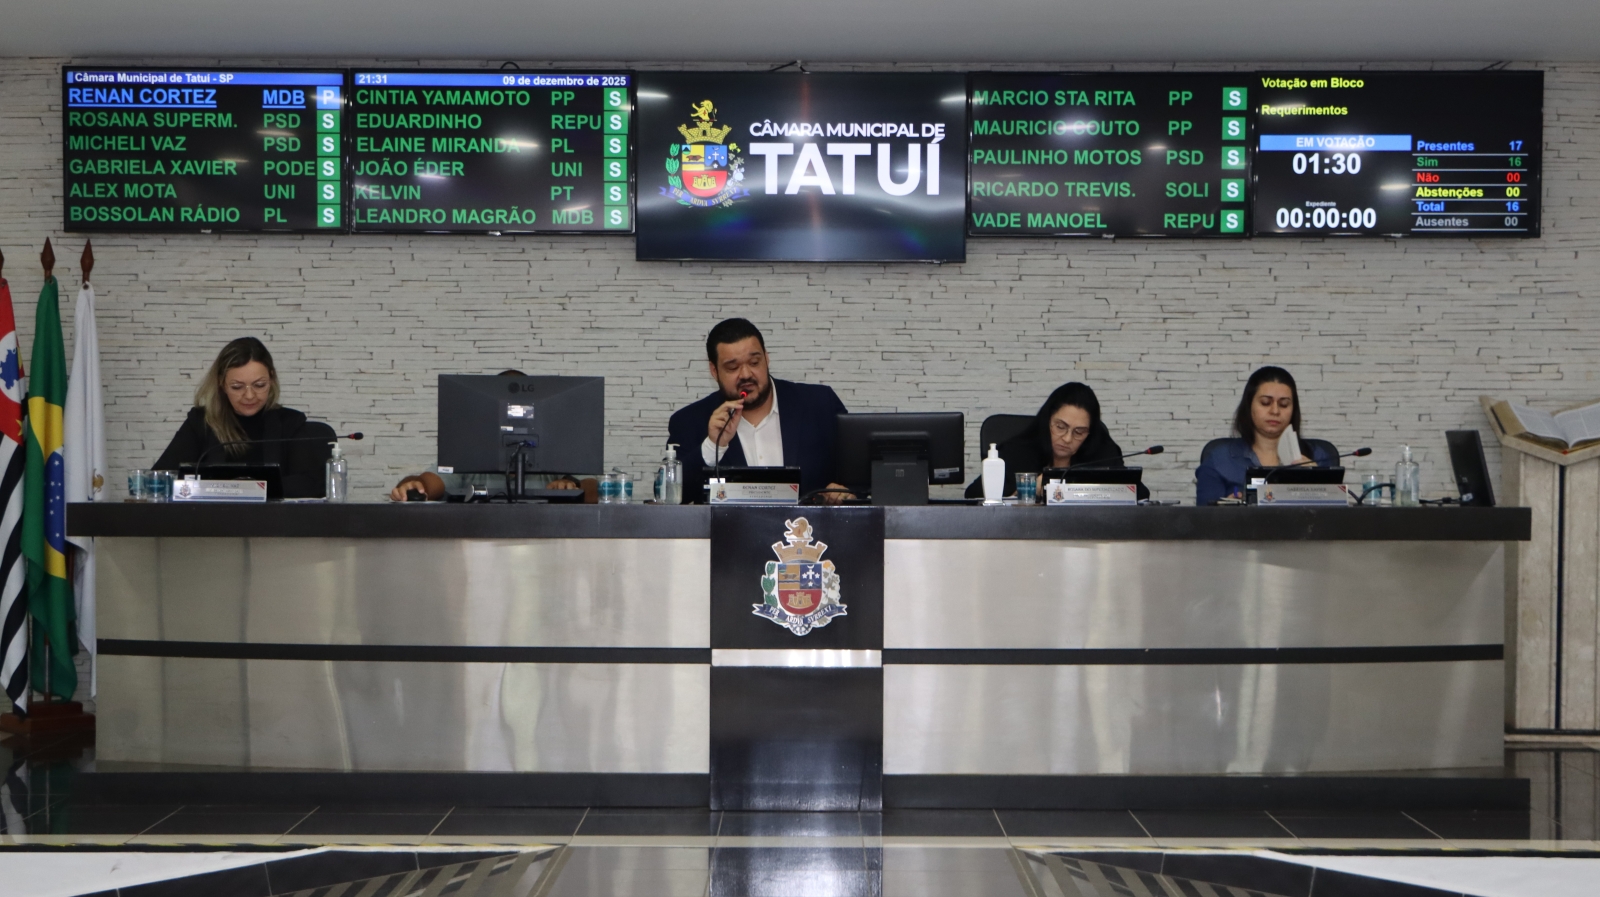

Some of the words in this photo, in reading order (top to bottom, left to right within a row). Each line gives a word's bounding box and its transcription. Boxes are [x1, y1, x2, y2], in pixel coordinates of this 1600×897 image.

[75, 73, 115, 83] Câmara
[117, 73, 167, 84] Municipal
[170, 74, 183, 83] de
[185, 73, 210, 83] Tatuí
[219, 74, 234, 83] SP
[359, 75, 387, 84] 21:31
[503, 76, 515, 85] 09
[518, 76, 531, 85] de
[533, 76, 584, 85] dezembro
[586, 77, 599, 85] de
[602, 77, 626, 86] 2025
[1262, 78, 1307, 90] Votação
[1310, 80, 1327, 88] em
[1331, 78, 1364, 88] Bloco
[69, 89, 133, 104] RENAN
[140, 89, 216, 104] CORTEZ
[263, 90, 305, 104] MDB
[323, 90, 334, 105] P
[356, 90, 418, 105] CINTIA
[422, 90, 530, 105] YAMAMOTO
[551, 92, 575, 106] PP
[609, 91, 621, 106] S
[973, 90, 1048, 105] MARCIO
[1054, 91, 1089, 105] STA
[1095, 91, 1135, 106] RITA
[1169, 91, 1193, 106] PP
[1229, 91, 1241, 106] S
[1261, 105, 1348, 116] Requerimentos
[69, 112, 148, 127] ROSANA
[154, 113, 237, 128] SUPERM.
[264, 114, 301, 128] PSD
[322, 113, 335, 129] S
[357, 114, 481, 129] EDUARDINHO
[551, 115, 600, 129] REPU
[610, 115, 622, 130] S
[750, 119, 824, 137] CÂMARA
[827, 123, 920, 138] MUNICIPAL
[922, 123, 945, 138] DE
[974, 120, 1066, 135] MAURICIO
[1073, 121, 1140, 135] COUTO
[1168, 121, 1192, 135] PP
[1228, 121, 1240, 136] S
[69, 136, 145, 150] MICHELI
[151, 136, 186, 151] VAZ
[264, 137, 301, 152] PSD
[322, 137, 335, 153] S
[357, 138, 425, 152] ELAINE
[432, 138, 520, 152] MIRANDA
[551, 139, 574, 153] PL
[609, 138, 622, 154] S
[1296, 137, 1313, 147] EM
[1316, 135, 1375, 149] VOTAÇÃO
[1417, 141, 1474, 151] Presentes
[1509, 141, 1522, 150] 17
[973, 150, 1068, 164] PAULINHO
[1074, 150, 1142, 165] MOTOS
[1167, 150, 1203, 165] PSD
[1227, 150, 1239, 165] S
[1292, 153, 1361, 174] 01:30
[1417, 157, 1438, 166] Sim
[1509, 157, 1522, 166] 16
[70, 160, 165, 174] GABRIELA
[170, 160, 237, 175] XAVIER
[264, 161, 315, 176] PODE
[322, 161, 335, 176] S
[356, 158, 407, 176] JOÃO
[414, 158, 465, 176] ÉDER
[551, 163, 582, 177] UNI
[609, 162, 622, 178] S
[749, 137, 945, 196] TATUÍ
[1417, 173, 1439, 182] Não
[1507, 173, 1520, 182] 00
[70, 183, 118, 198] ALEX
[125, 183, 177, 198] MOTA
[264, 185, 295, 199] UNI
[322, 185, 335, 200] S
[355, 185, 421, 200] KELVIN
[551, 186, 574, 201] PT
[609, 186, 622, 201] S
[973, 182, 1058, 197] RICARDO
[1065, 182, 1136, 197] TREVIS.
[1166, 183, 1208, 197] SOLI
[1227, 182, 1239, 197] S
[1416, 187, 1483, 199] Abstenções
[1506, 188, 1520, 197] 00
[71, 206, 174, 221] BOSSOLAN
[180, 204, 239, 222] RÁDIO
[264, 208, 287, 222] PL
[322, 208, 335, 224] S
[1416, 202, 1444, 211] Total
[1506, 202, 1519, 211] 16
[356, 209, 446, 224] LEANDRO
[453, 206, 536, 224] MAGRÃO
[552, 210, 593, 224] MDB
[610, 210, 622, 225] S
[973, 213, 1021, 227] VADE
[1028, 213, 1107, 228] MANOEL
[1164, 214, 1214, 228] REPU
[1226, 214, 1238, 229] S
[1276, 208, 1376, 228] 00:00:00
[1416, 217, 1469, 227] Ausentes
[1504, 217, 1518, 226] 00
[769, 607, 779, 616] PER
